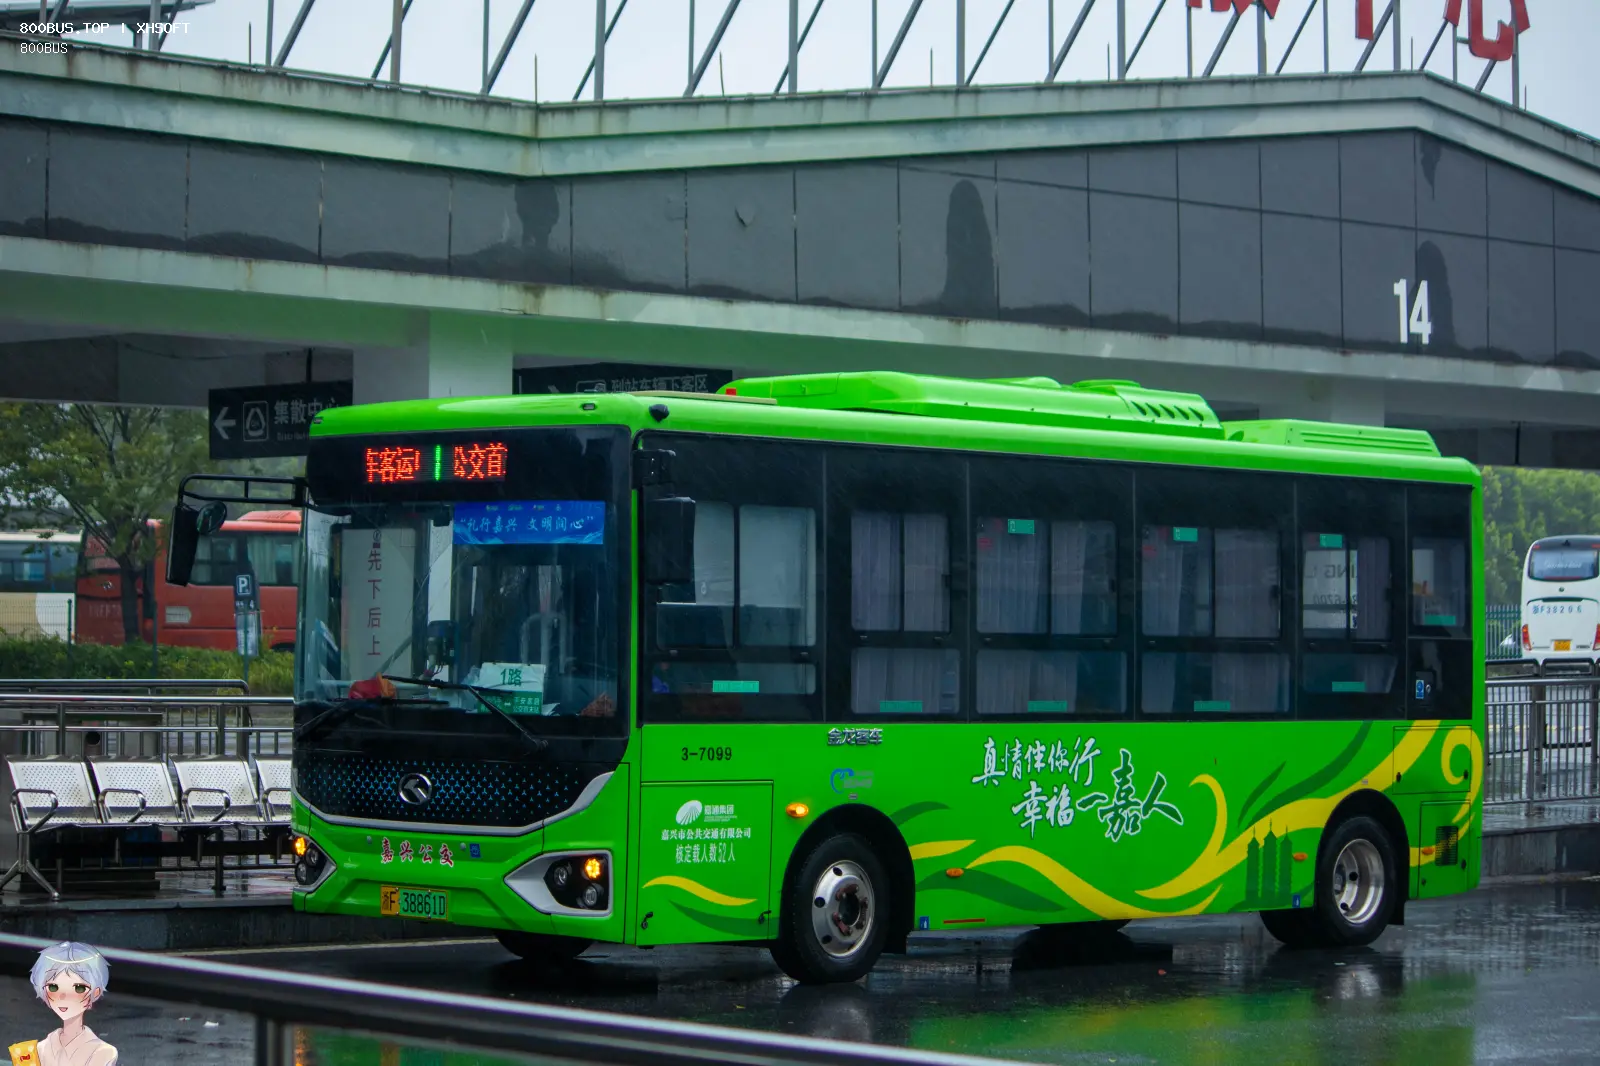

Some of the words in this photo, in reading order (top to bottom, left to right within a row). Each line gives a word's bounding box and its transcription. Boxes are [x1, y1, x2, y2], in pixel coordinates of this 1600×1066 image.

[1393, 278, 1432, 345] 14
[238, 577, 248, 593] P
[367, 549, 383, 657] 先下后上
[500, 668, 522, 687] 1路
[827, 727, 883, 746] 金龙客车
[681, 747, 733, 761] 3-7099
[972, 736, 1101, 787] 真情伴你行
[1011, 747, 1184, 843] 幸福一嘉人
[661, 827, 752, 841] 嘉兴市公共交通有限公司
[380, 836, 455, 868] 嘉兴公交
[675, 842, 736, 865] 核定载人数52人
